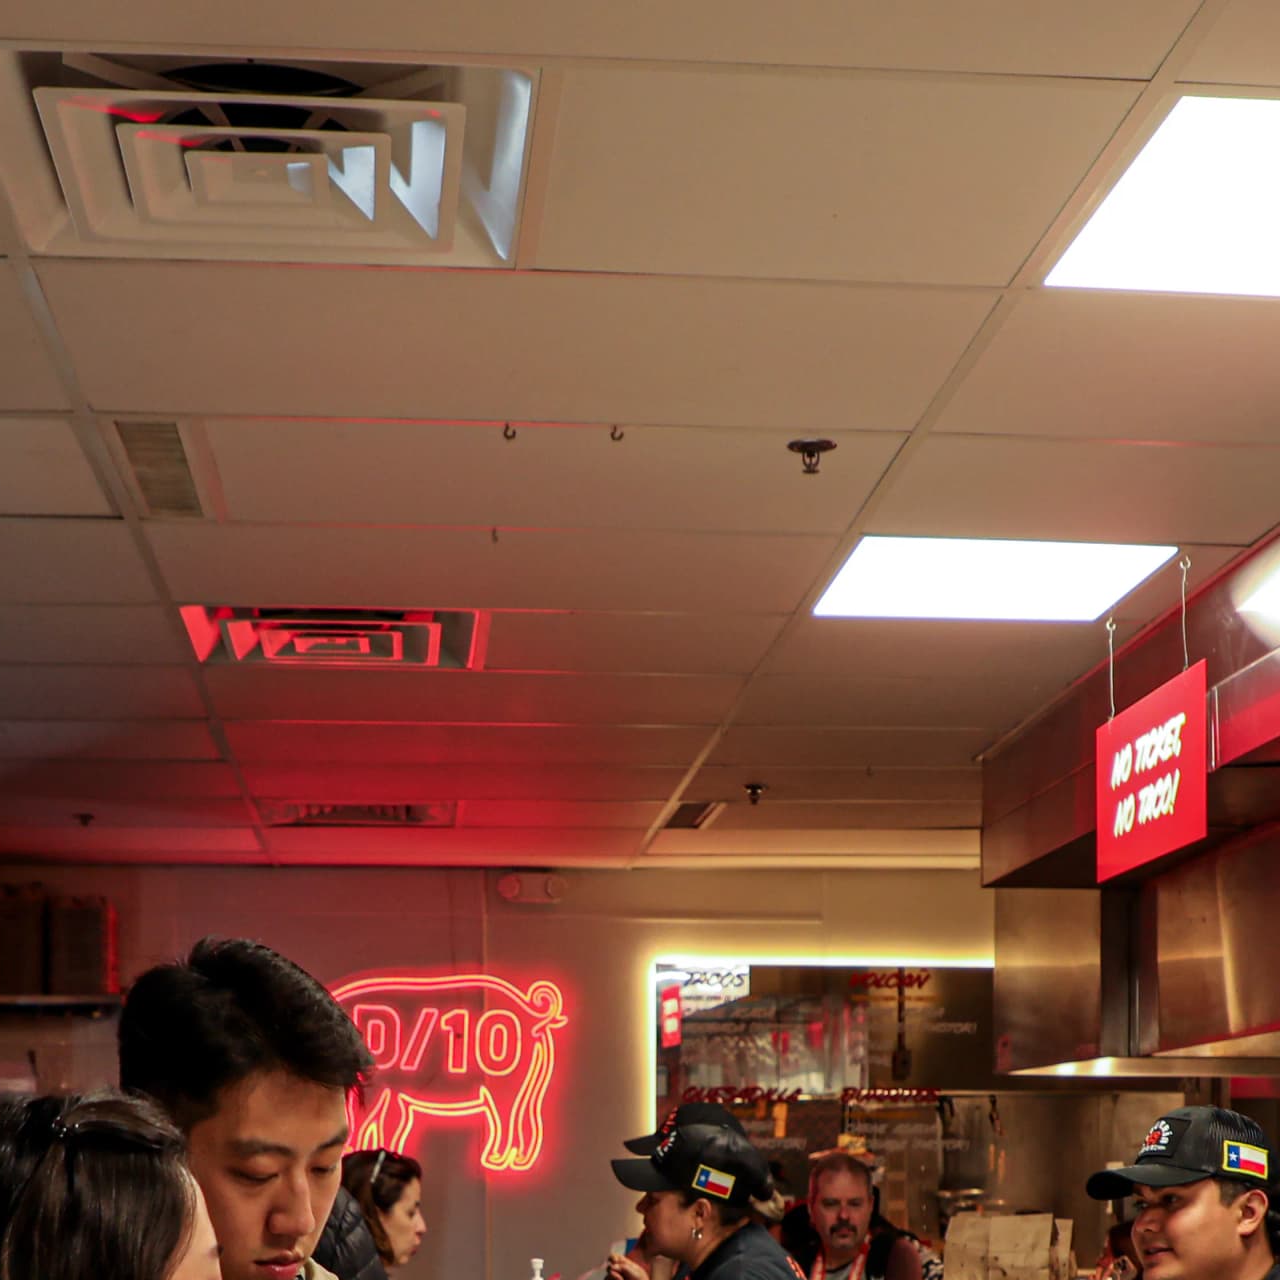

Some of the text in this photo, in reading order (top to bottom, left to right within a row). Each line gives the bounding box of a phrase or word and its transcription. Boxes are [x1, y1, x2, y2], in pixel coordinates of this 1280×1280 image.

[1111, 742, 1133, 791] NO
[1114, 768, 1180, 838] NO TACO!
